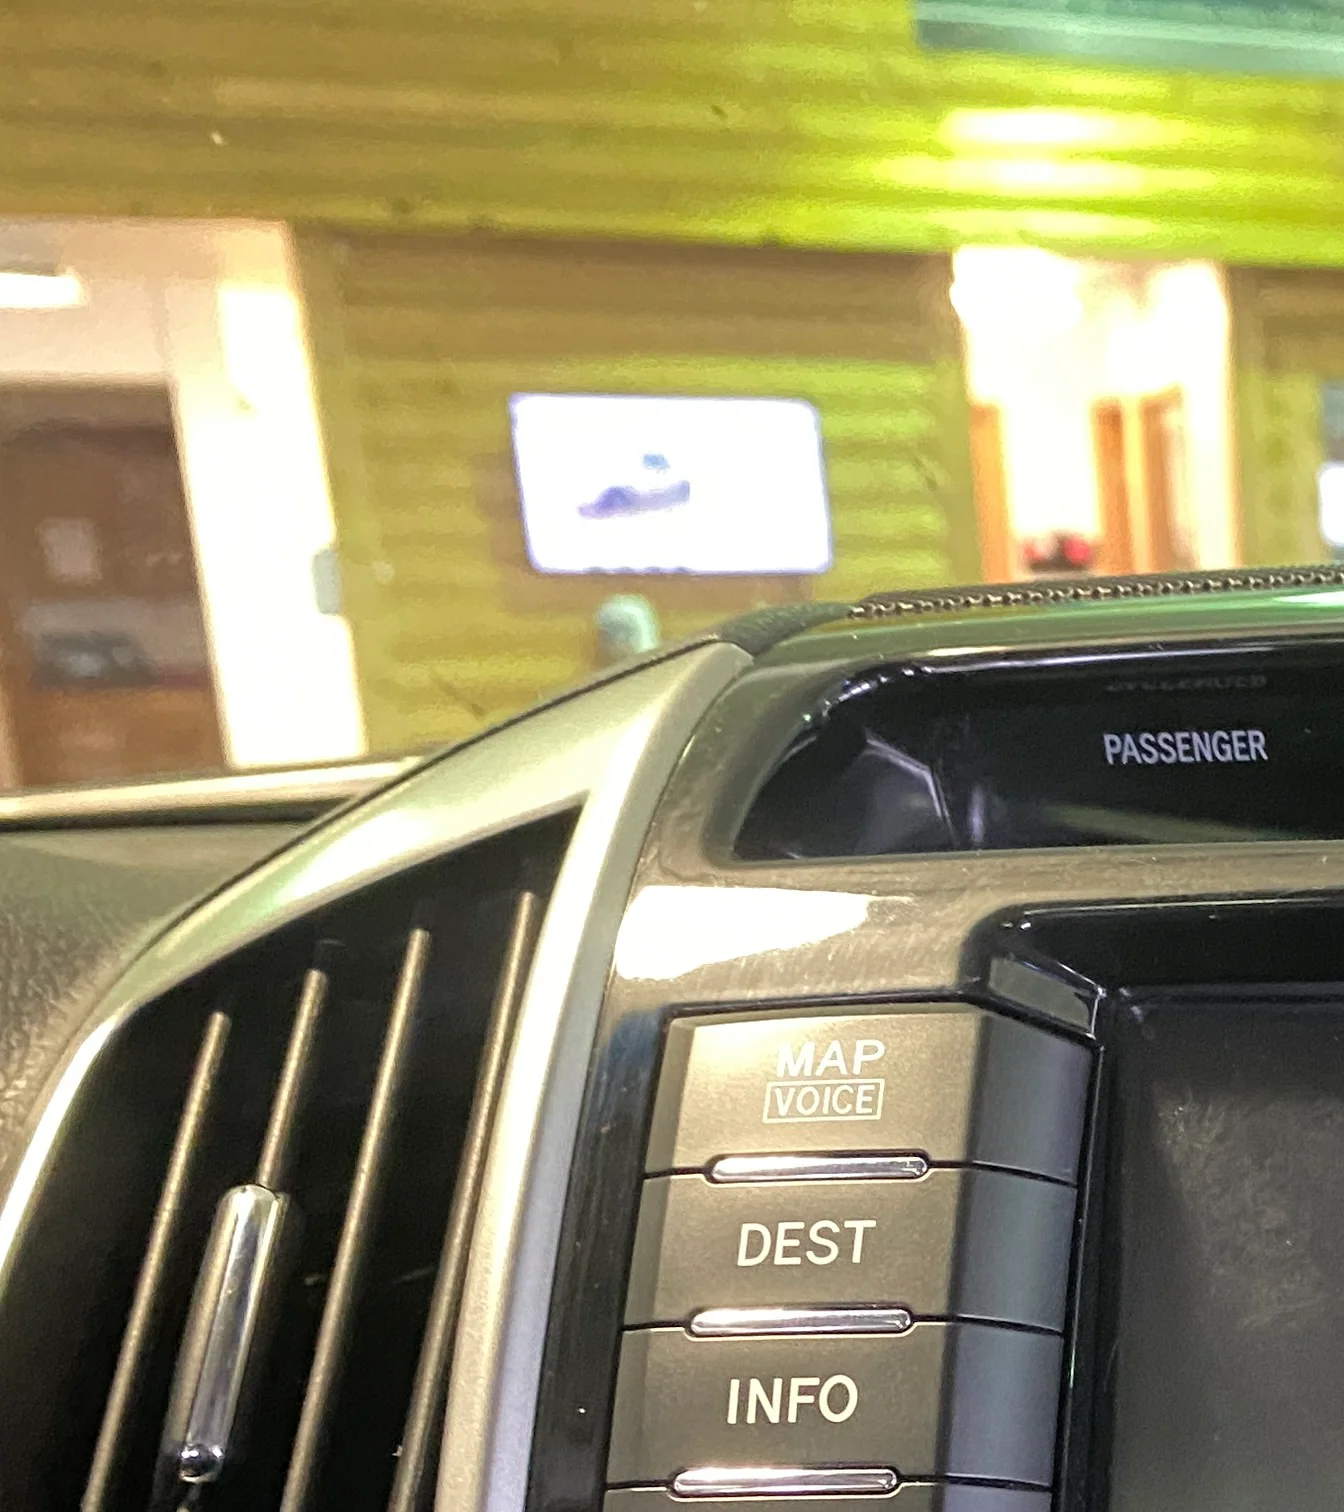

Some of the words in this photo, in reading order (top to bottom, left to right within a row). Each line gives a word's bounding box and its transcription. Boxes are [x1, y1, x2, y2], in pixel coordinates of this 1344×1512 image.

[1103, 729, 1268, 765] PASSENGER
[776, 1039, 885, 1077] MAP
[774, 1083, 877, 1117] VOICE
[736, 1219, 877, 1267] DEST
[726, 1373, 859, 1425] INFO
